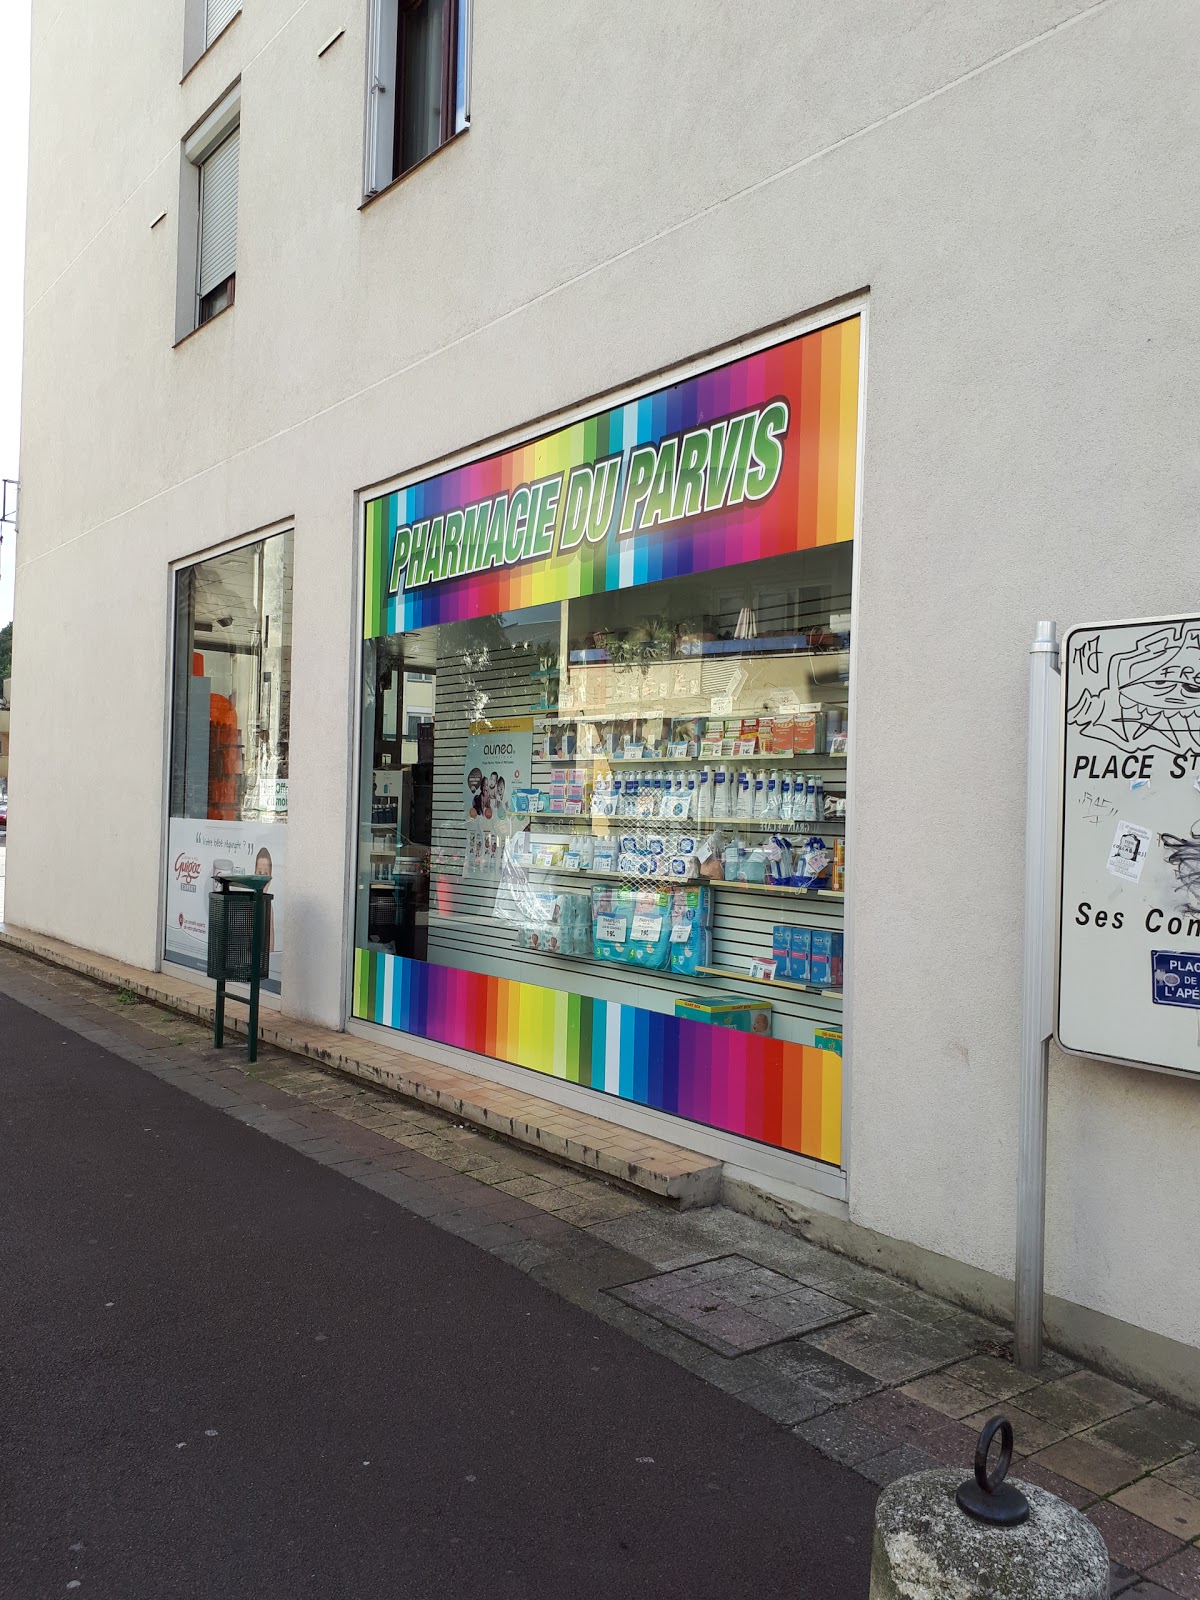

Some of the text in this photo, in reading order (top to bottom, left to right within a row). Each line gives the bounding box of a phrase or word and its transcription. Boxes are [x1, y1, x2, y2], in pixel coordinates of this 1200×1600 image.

[388, 401, 789, 593] PHARMACIE DU PARVIS
[1073, 755, 1154, 779] PLACE
[1075, 902, 1124, 929] Ses
[1184, 976, 1197, 986] DE
